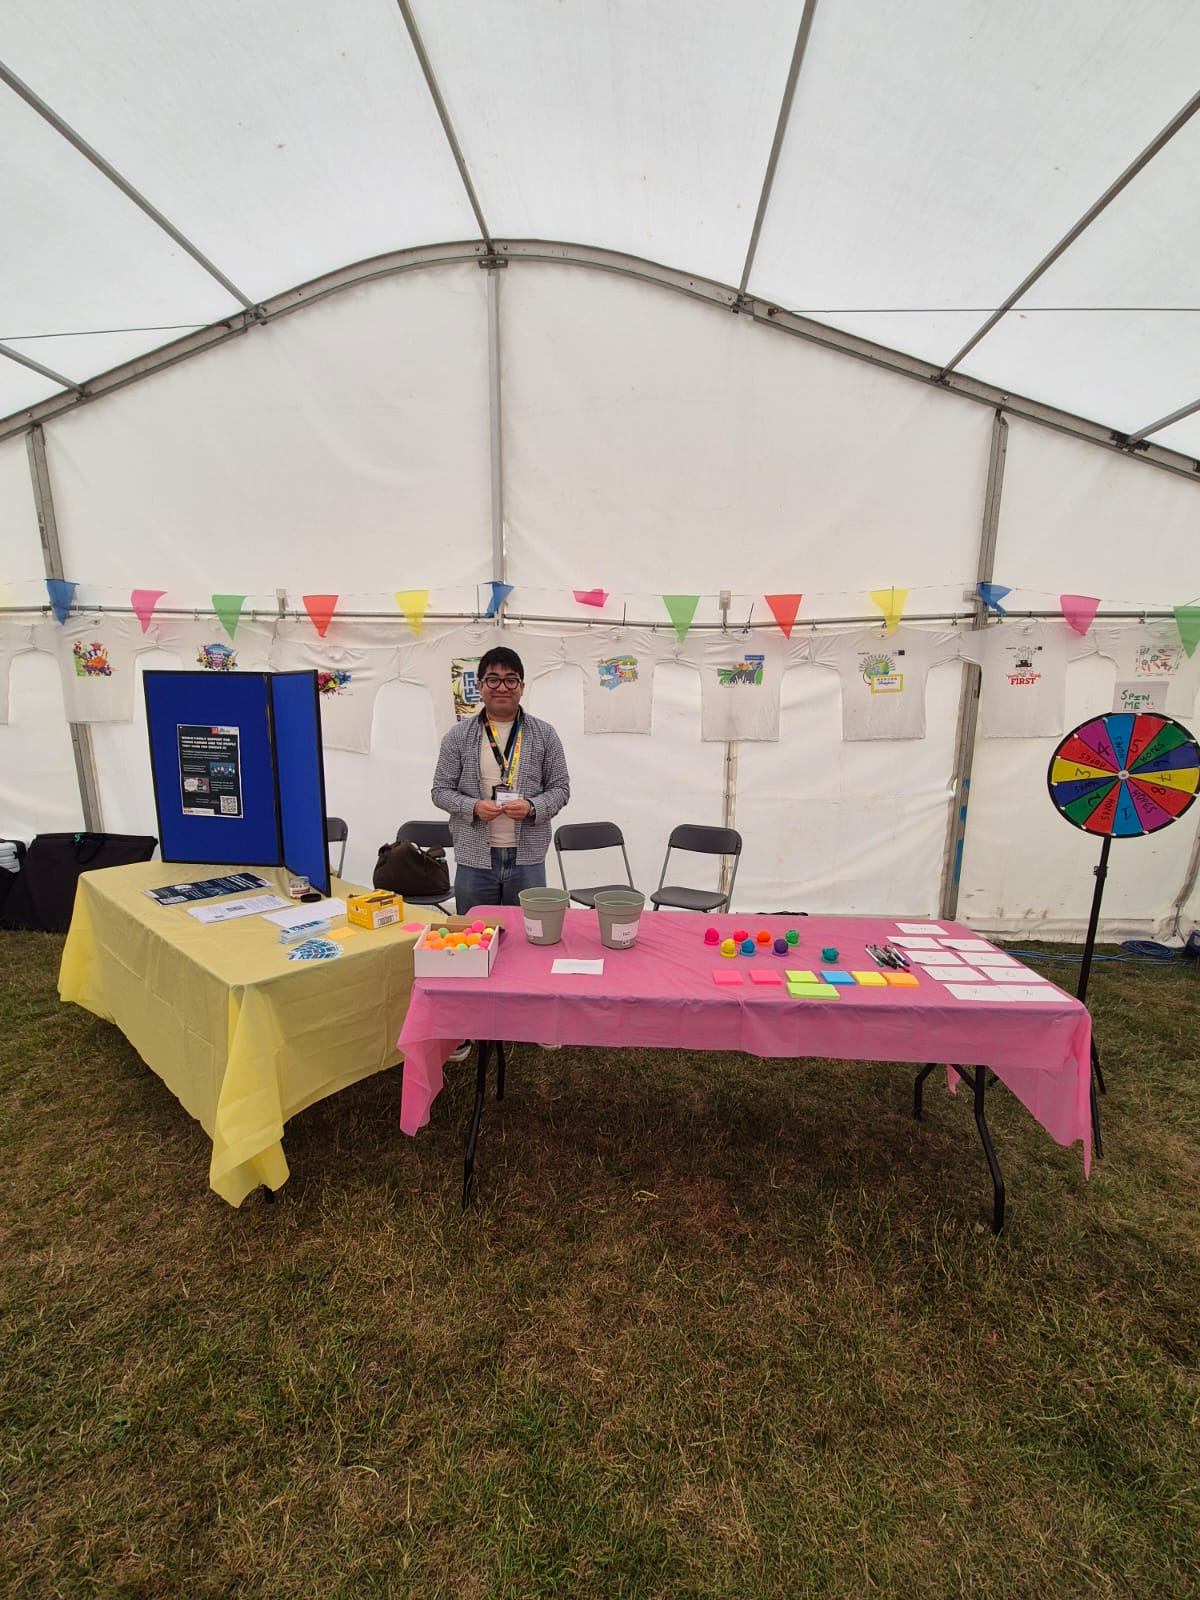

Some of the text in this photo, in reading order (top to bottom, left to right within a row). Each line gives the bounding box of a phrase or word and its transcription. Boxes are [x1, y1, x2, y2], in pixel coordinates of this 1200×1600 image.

[1010, 677, 1036, 685] FIRST
[1120, 689, 1150, 701] SPIN
[1124, 701, 1141, 710] ME
[1097, 741, 1111, 756] 4
[1130, 738, 1144, 754] 5
[1140, 742, 1164, 763] HOPES
[1078, 752, 1107, 768] HOPES
[1074, 767, 1091, 778] 3
[1155, 773, 1172, 782] 7
[1150, 786, 1167, 796] 8
[1087, 792, 1102, 808] 2
[1131, 789, 1158, 814] HOPES
[1120, 806, 1133, 821] 1
